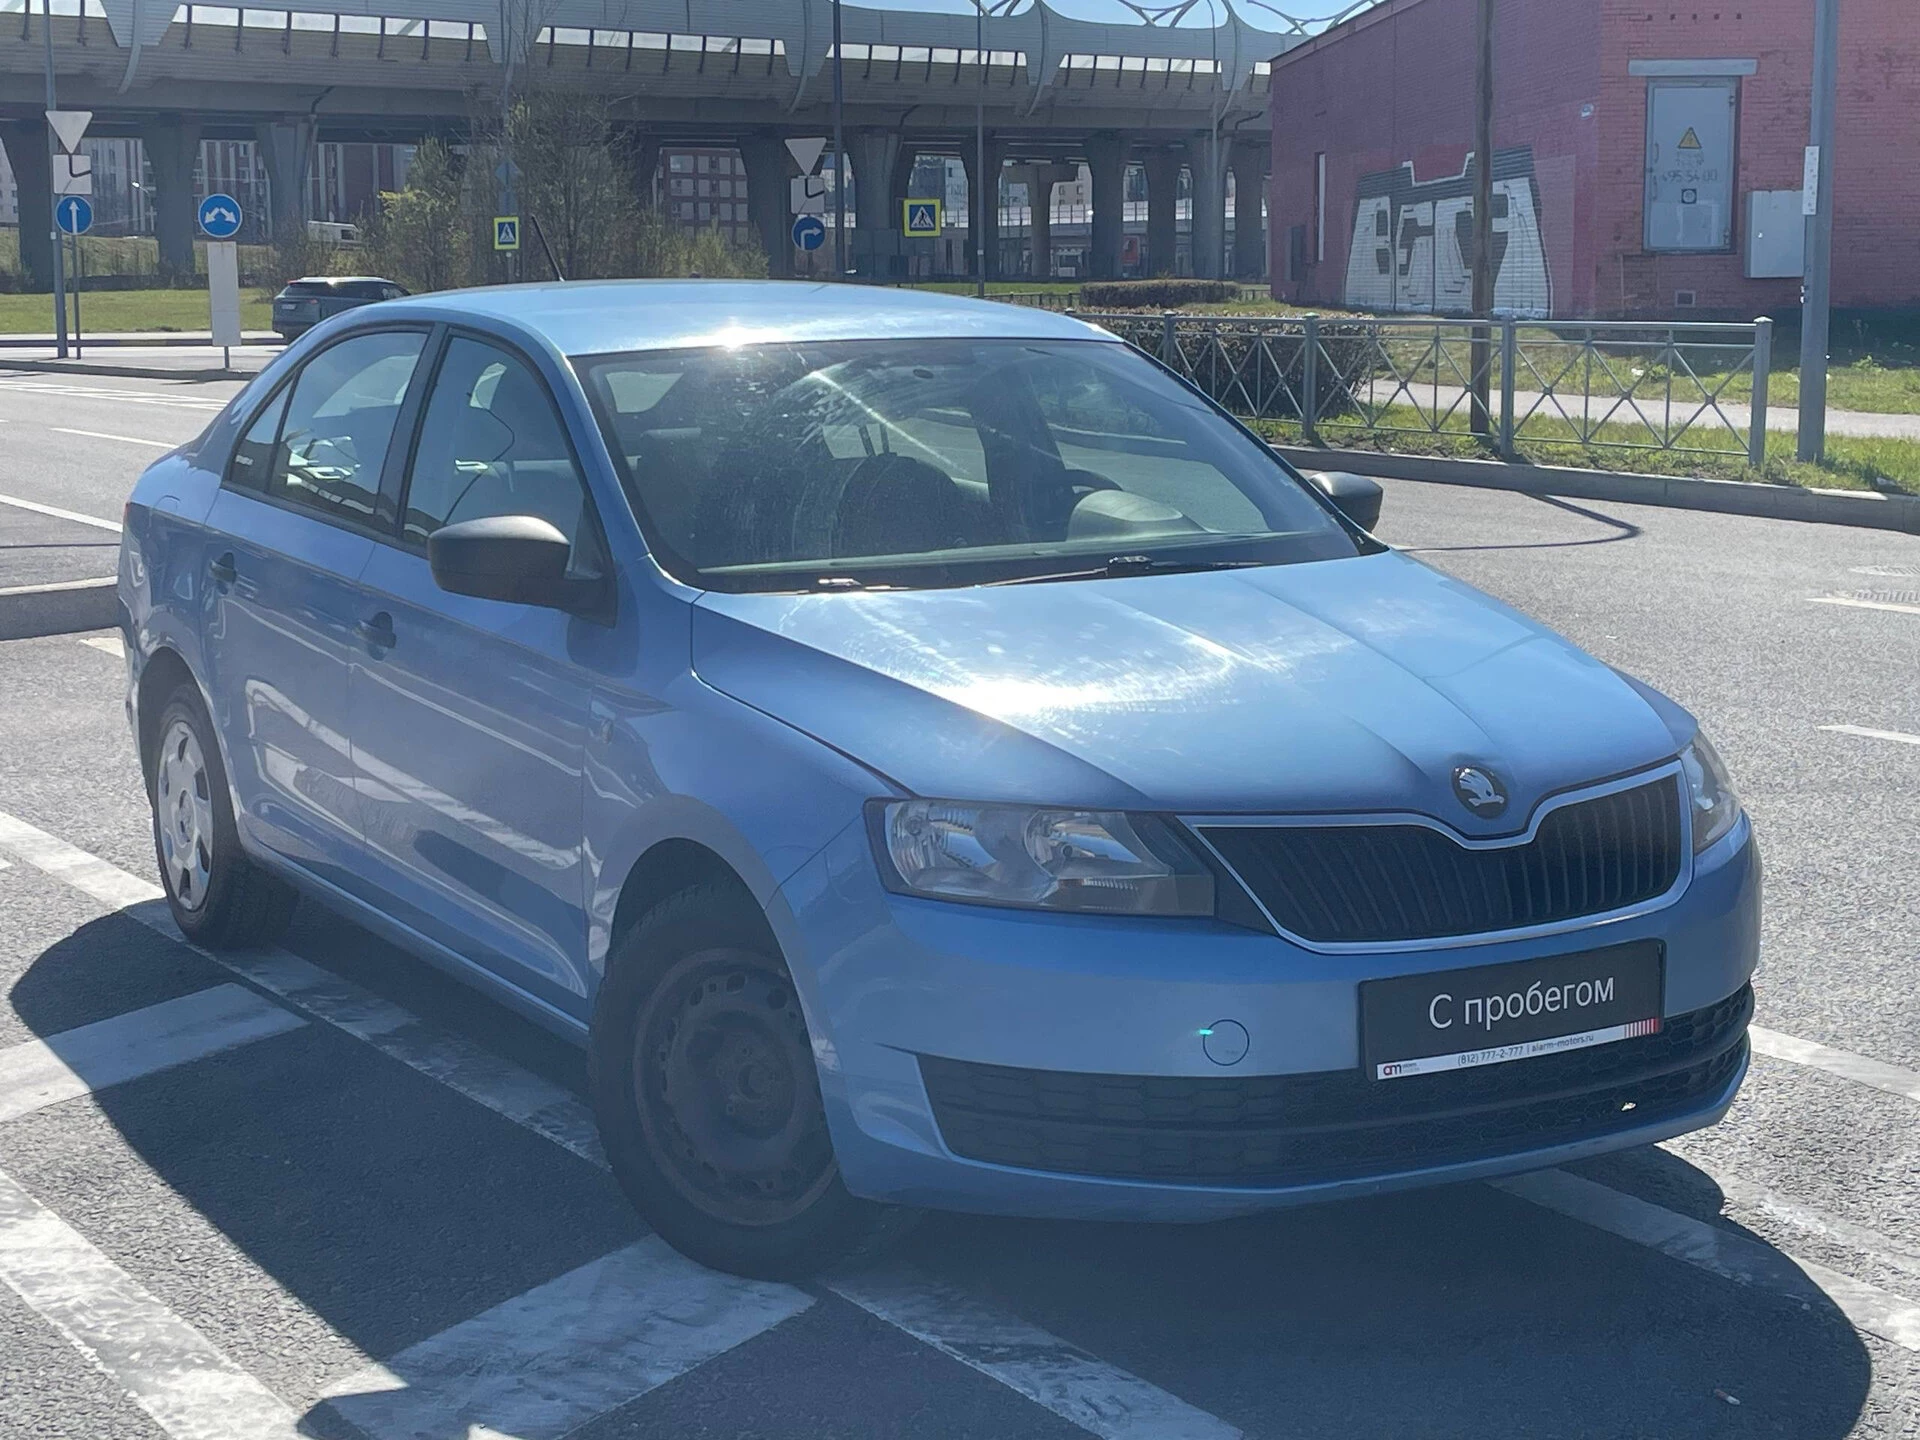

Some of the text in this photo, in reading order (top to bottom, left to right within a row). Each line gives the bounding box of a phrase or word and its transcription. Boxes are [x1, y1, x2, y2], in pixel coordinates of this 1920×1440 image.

[1428, 976, 1615, 1031] С пробегом
[1457, 1033, 1595, 1067] (812) 777-2-777 alarm-motors.ru
